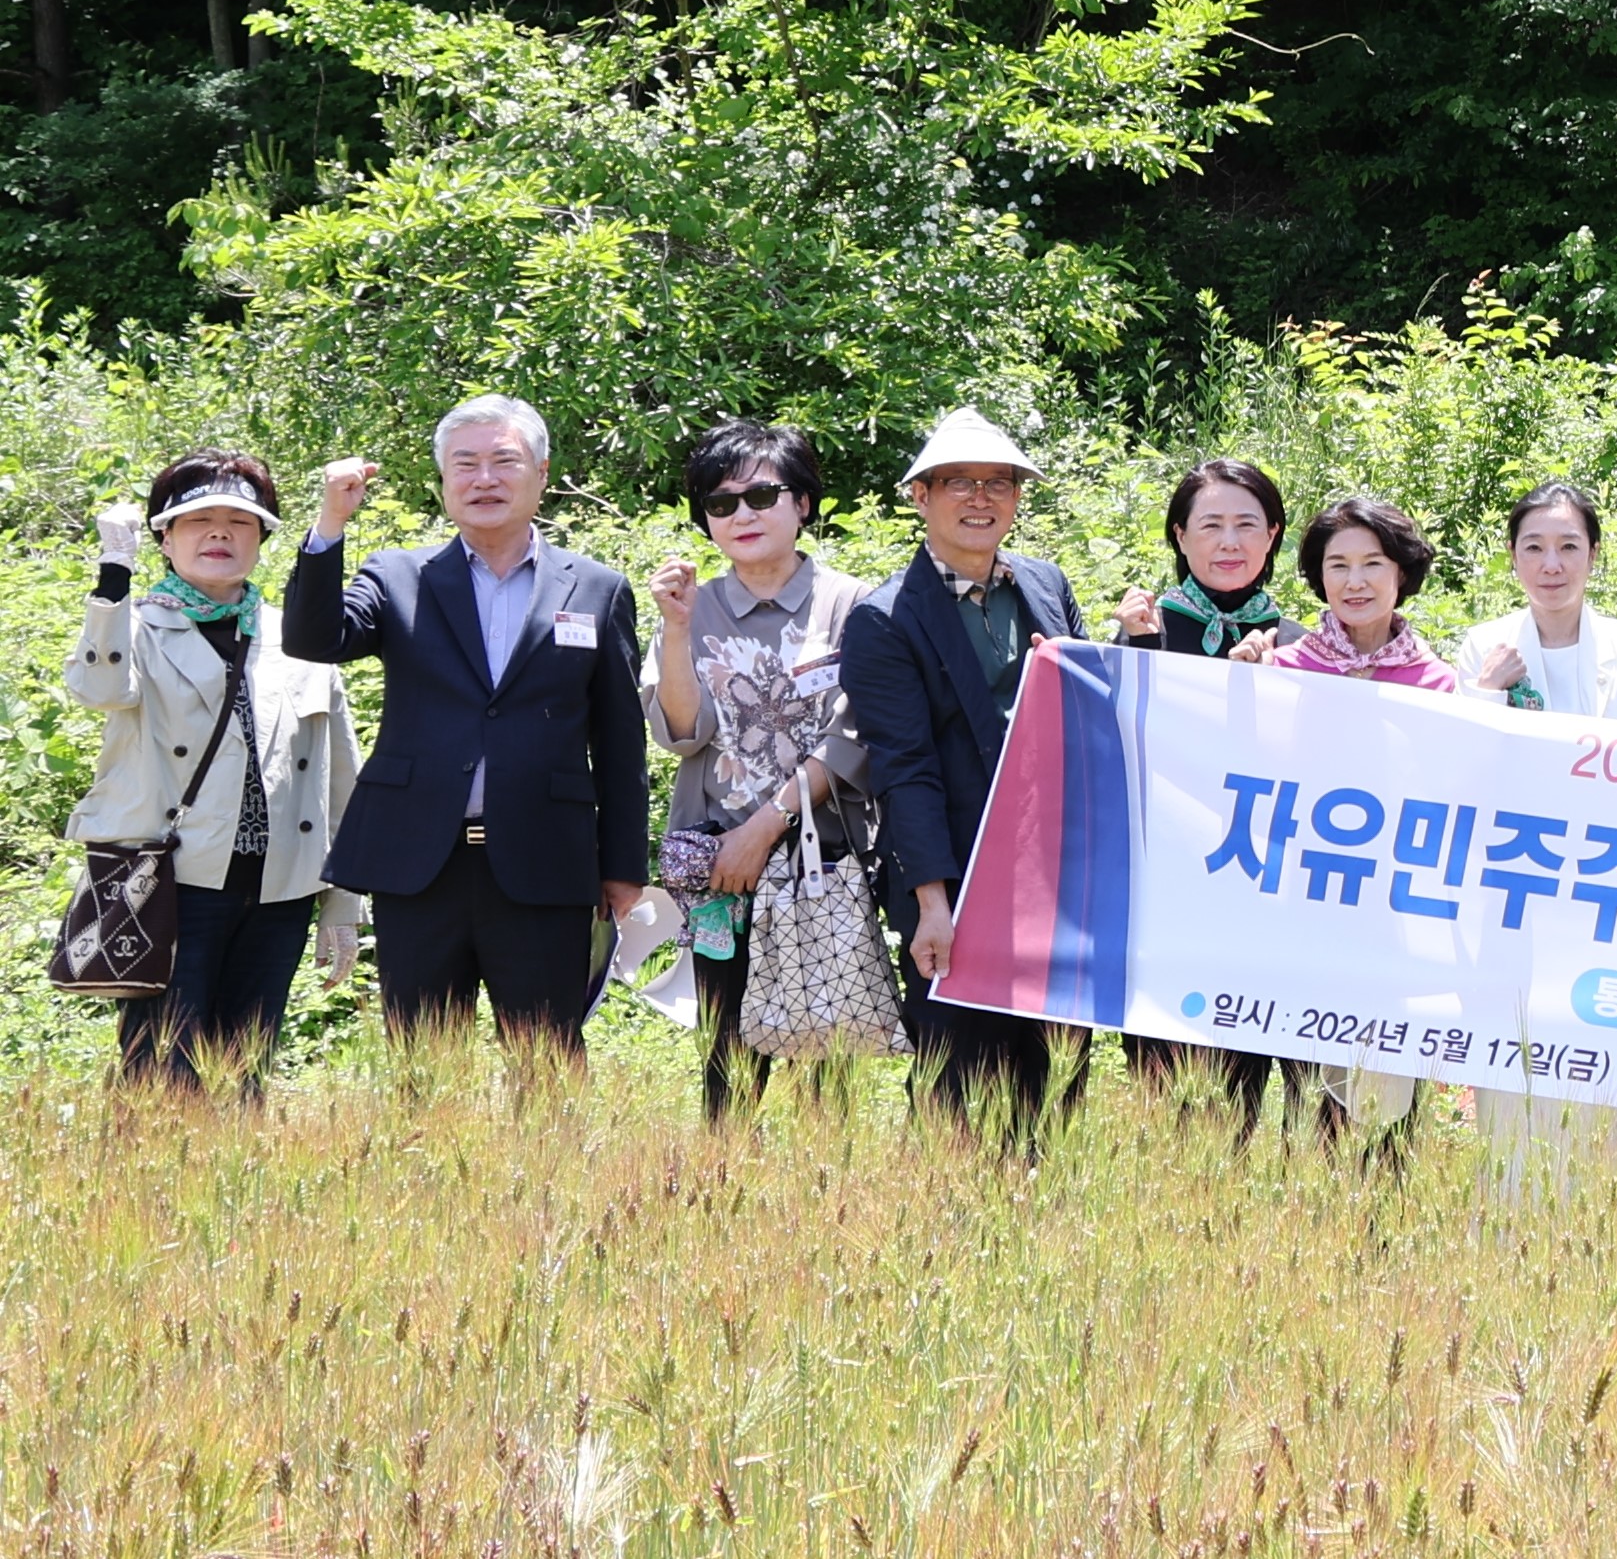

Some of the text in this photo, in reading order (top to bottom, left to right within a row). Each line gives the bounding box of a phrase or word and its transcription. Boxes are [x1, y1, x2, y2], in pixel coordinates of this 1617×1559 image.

[1212, 993, 1276, 1034] 일시
[1296, 1008, 1410, 1053] 2024년
[1419, 1027, 1473, 1064] 5월
[1487, 1038, 1611, 1086] 17일(금)
